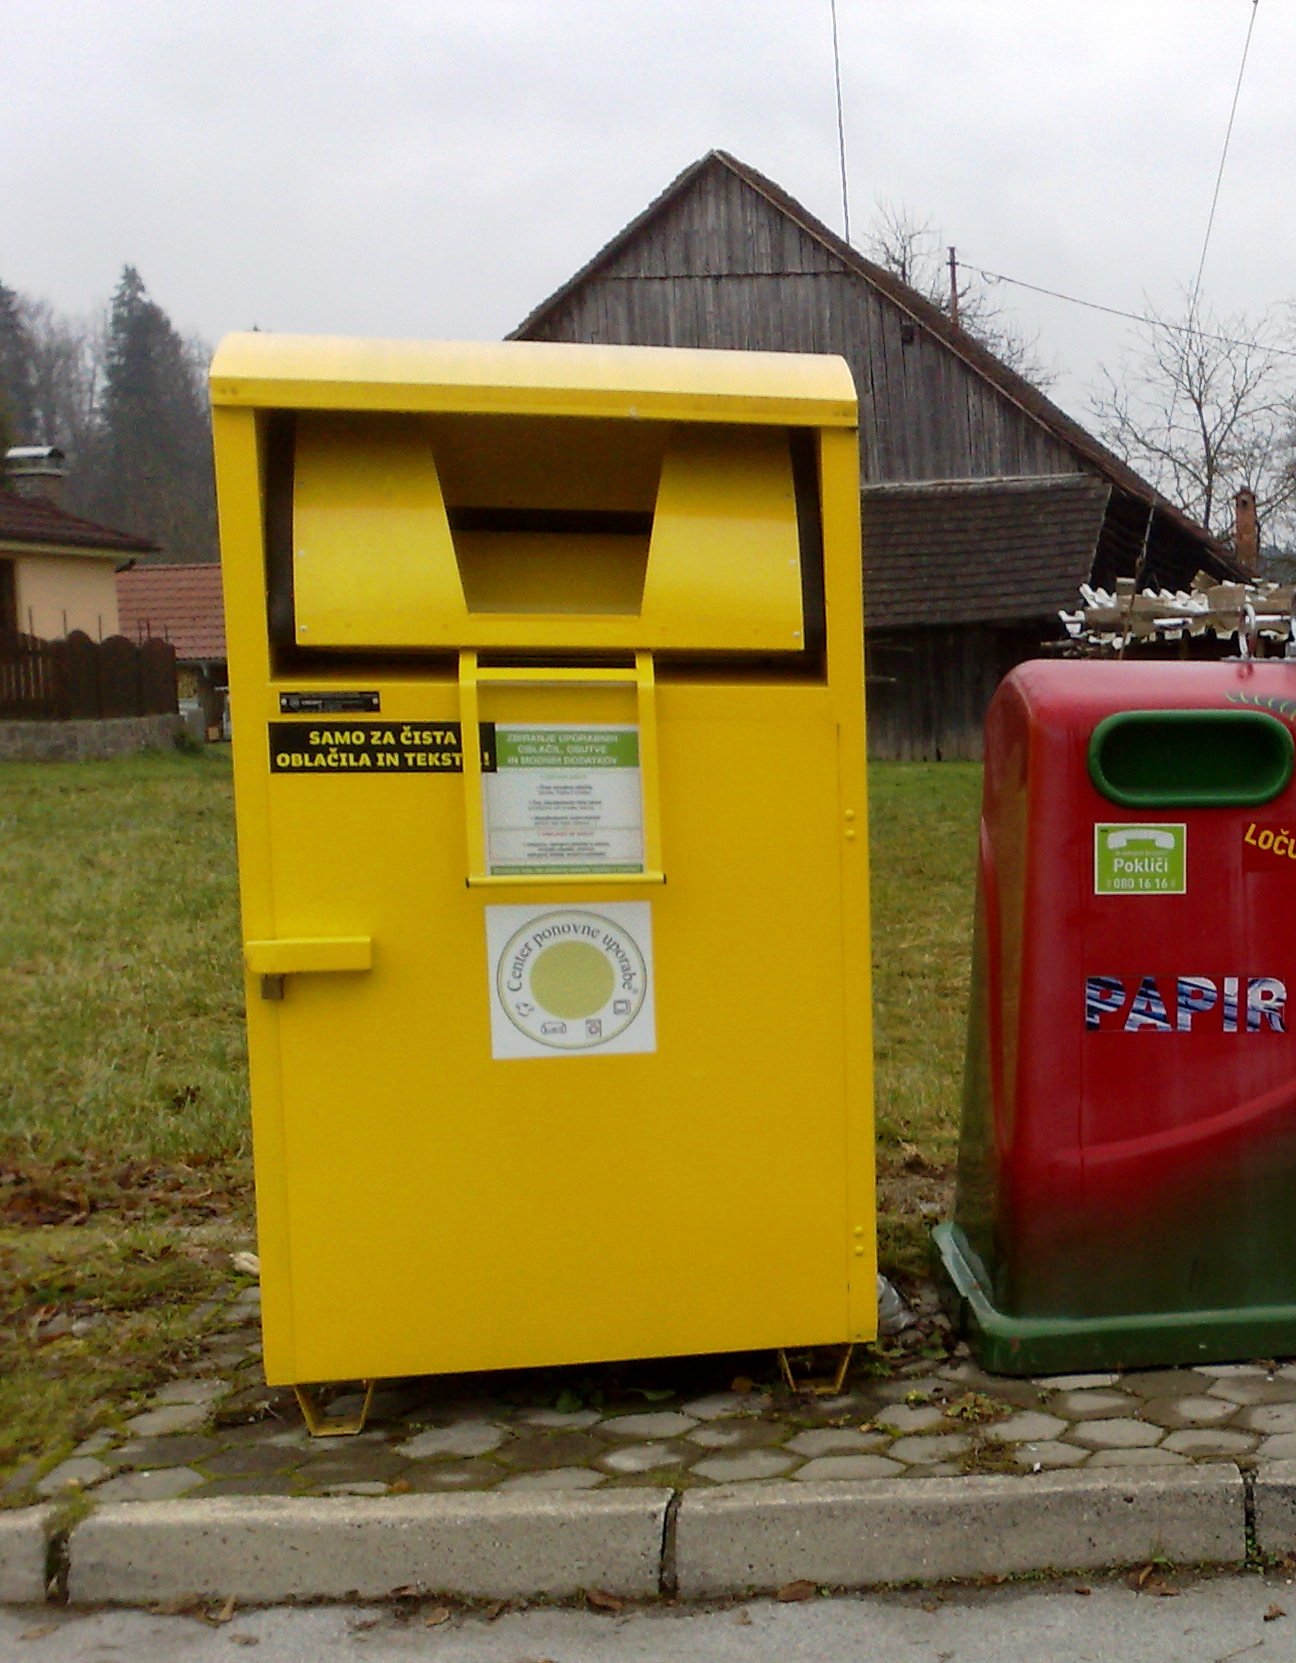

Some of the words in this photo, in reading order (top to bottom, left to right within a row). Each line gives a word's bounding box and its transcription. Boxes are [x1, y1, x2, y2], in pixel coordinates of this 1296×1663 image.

[309, 731, 365, 745] SAMO
[370, 731, 396, 745] ZA
[401, 725, 457, 745] ČISTA
[276, 748, 371, 767] OBLAČILA
[376, 752, 399, 766] IN
[1113, 857, 1168, 873] Pokliči
[1139, 878, 1152, 889] 16
[1155, 878, 1168, 889] 16
[507, 942, 535, 993] Center
[533, 923, 601, 947] ponovne
[602, 933, 637, 991] uporabe
[1085, 976, 1287, 1032] PAPIR
